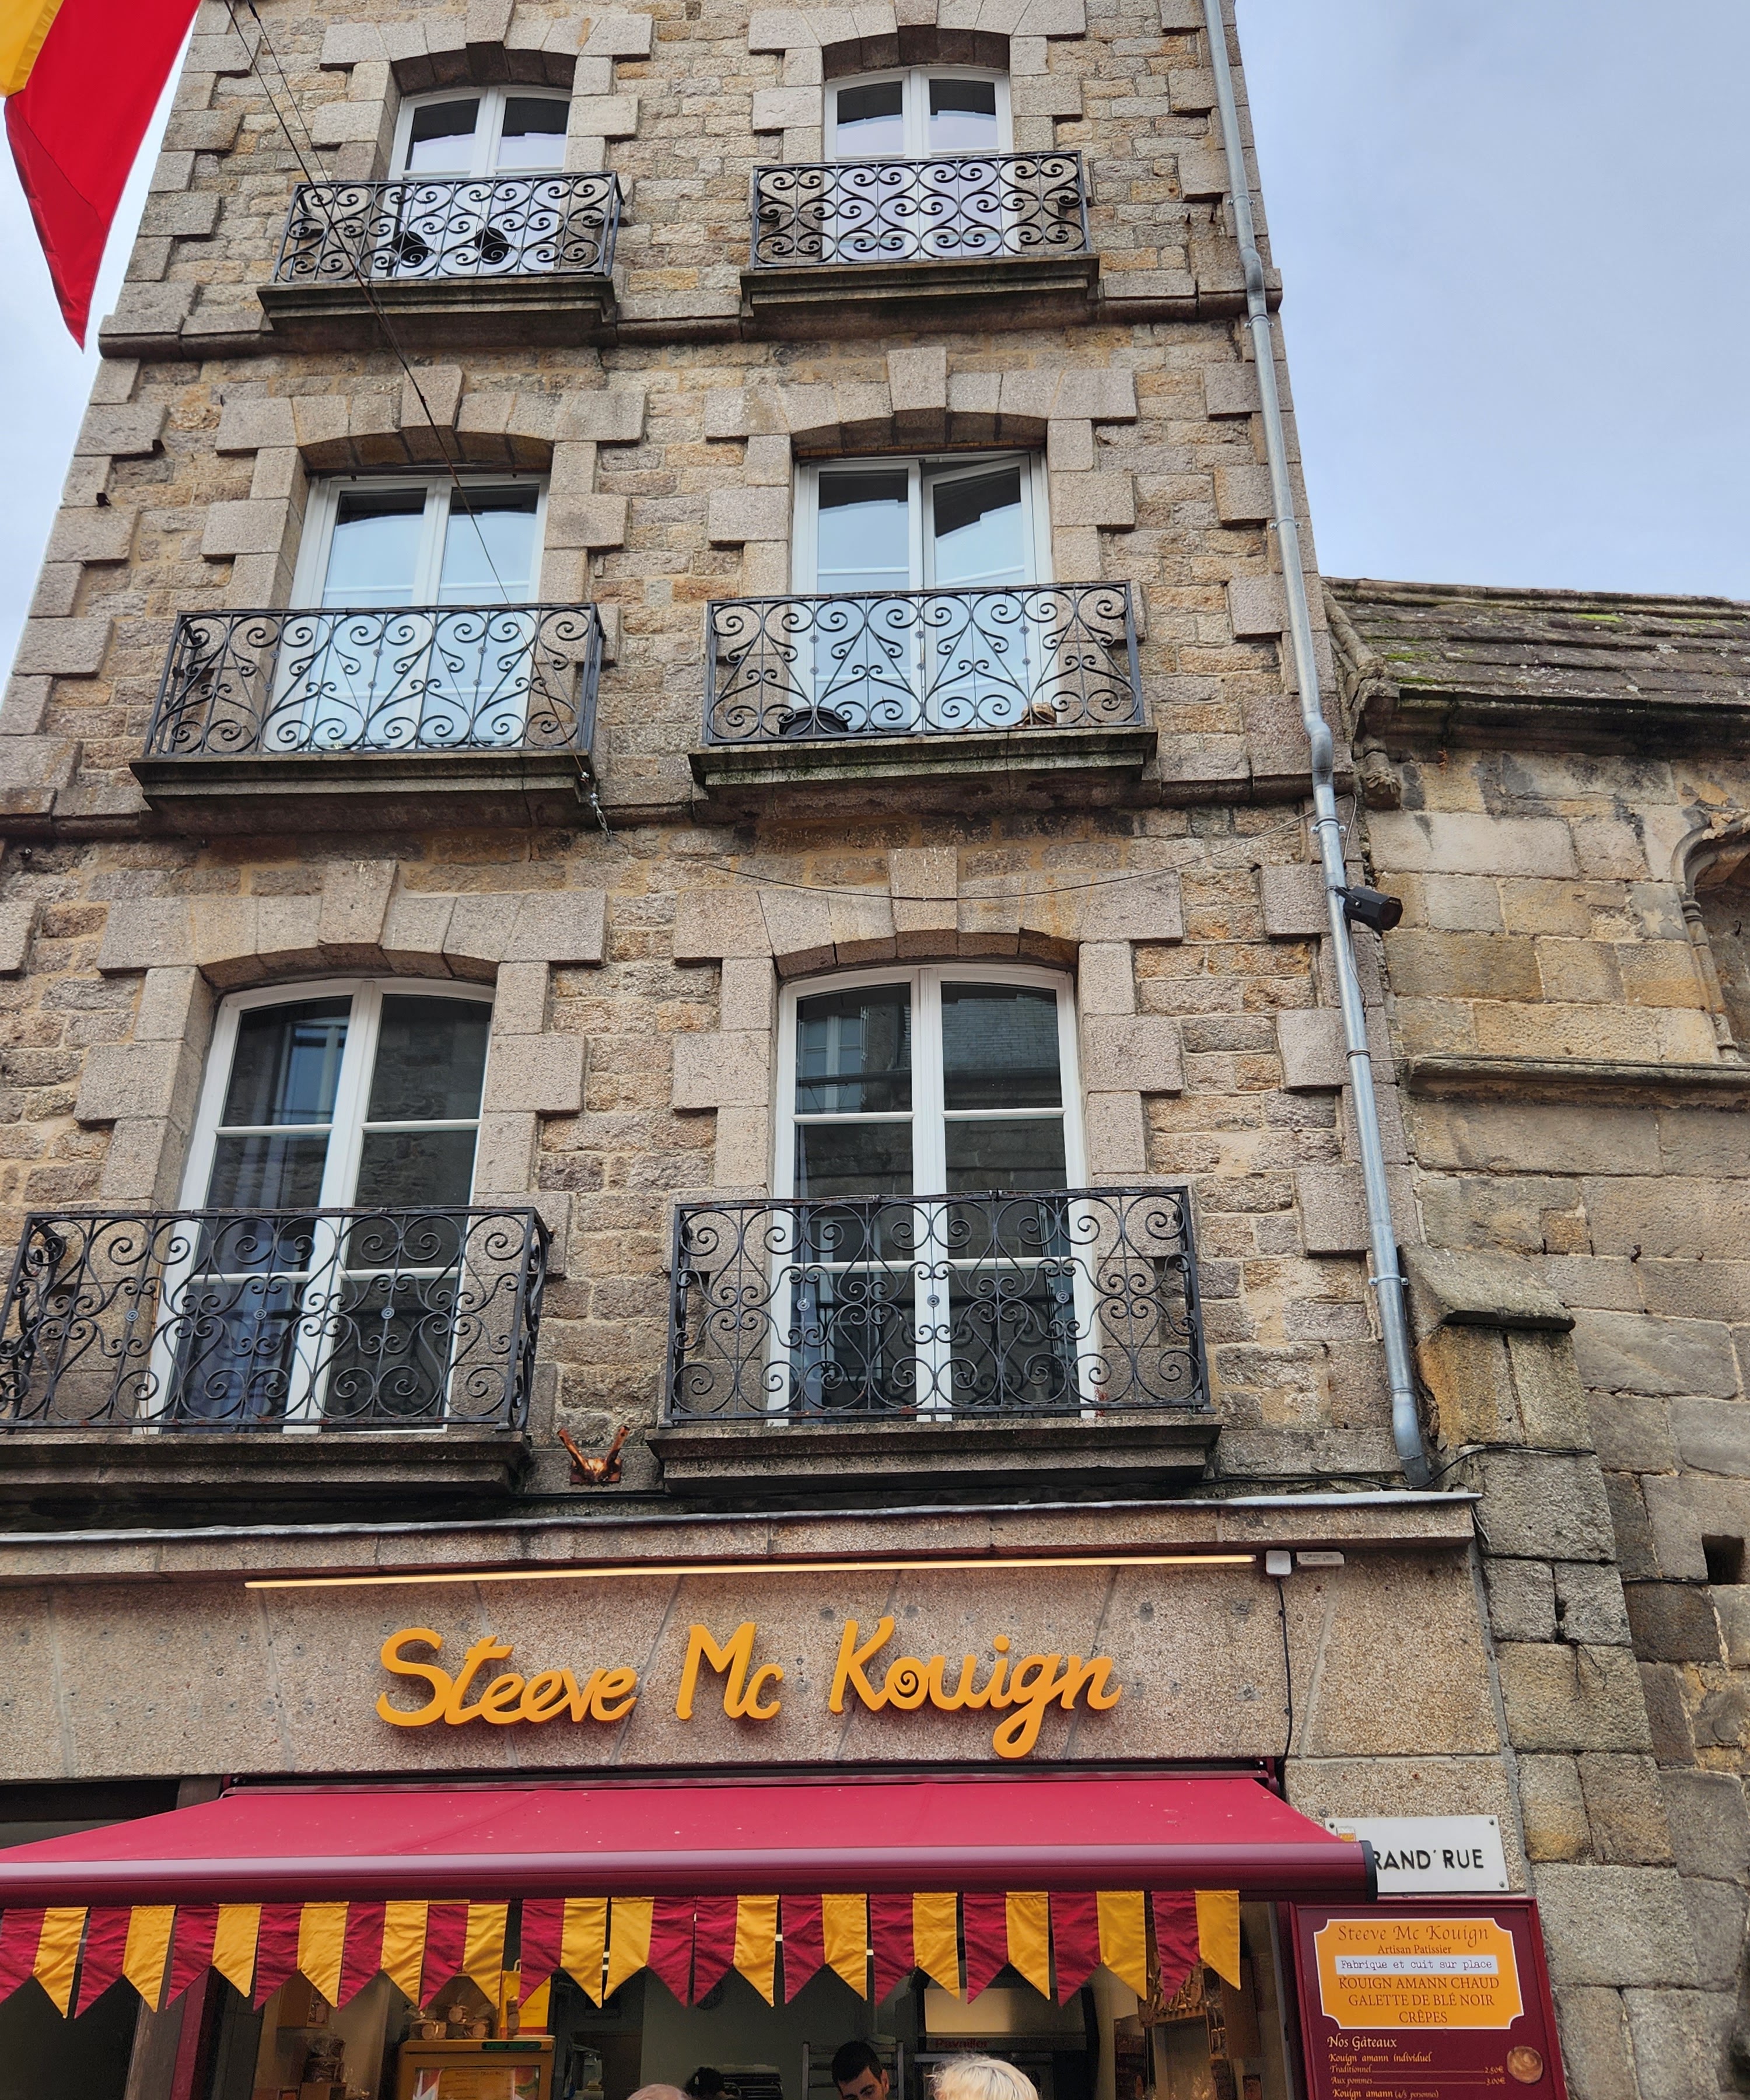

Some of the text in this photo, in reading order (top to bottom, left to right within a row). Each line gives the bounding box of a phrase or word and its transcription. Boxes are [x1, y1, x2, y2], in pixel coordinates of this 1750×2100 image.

[376, 1615, 1124, 1759] Steeve Mc Kouign
[1374, 1849, 1484, 1870] RAND' RUE
[1338, 1925, 1489, 1948] Steeve Mc Kouign
[1378, 1944, 1452, 1954] Artisan Patissier
[1340, 1959, 1492, 1971] Fabrique et cuit sur place
[1339, 1977, 1499, 1989] KOUIGN AMANN CHAUD
[1348, 1992, 1495, 2006] GALETTE DE BLÉ NOIR
[1398, 2009, 1447, 2024] CRÊPES
[1327, 2033, 1397, 2051] Nos Gâteaux
[1328, 2053, 1357, 2066] Kouign
[1393, 2052, 1432, 2063] individuel
[1329, 2063, 1372, 2073] Traditionnel
[1331, 2076, 1346, 2084] Aux
[1346, 2078, 1373, 2087] pommes
[1332, 2089, 1362, 2100] Kouign
